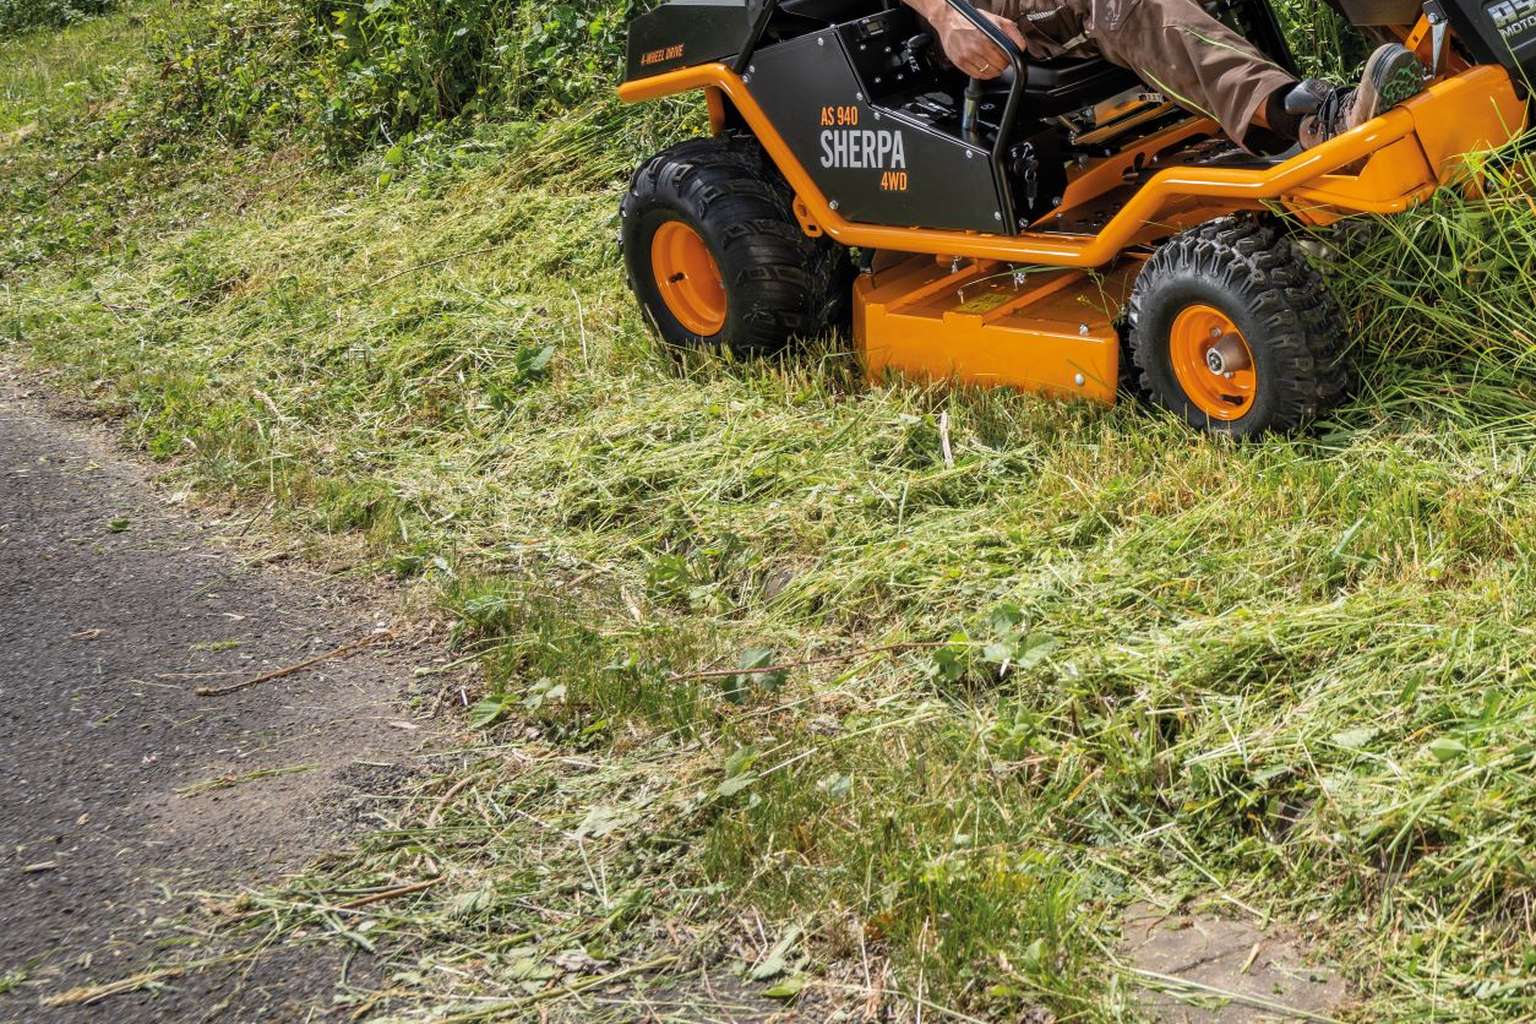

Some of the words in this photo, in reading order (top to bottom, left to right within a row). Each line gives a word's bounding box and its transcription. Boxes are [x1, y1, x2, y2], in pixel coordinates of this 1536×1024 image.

[641, 48, 665, 65] 4-WHEEL
[665, 43, 685, 60] DRIVE
[820, 106, 835, 127] AS
[837, 105, 859, 127] 940
[820, 130, 906, 169] SHERPA
[880, 171, 908, 192] 4WD
